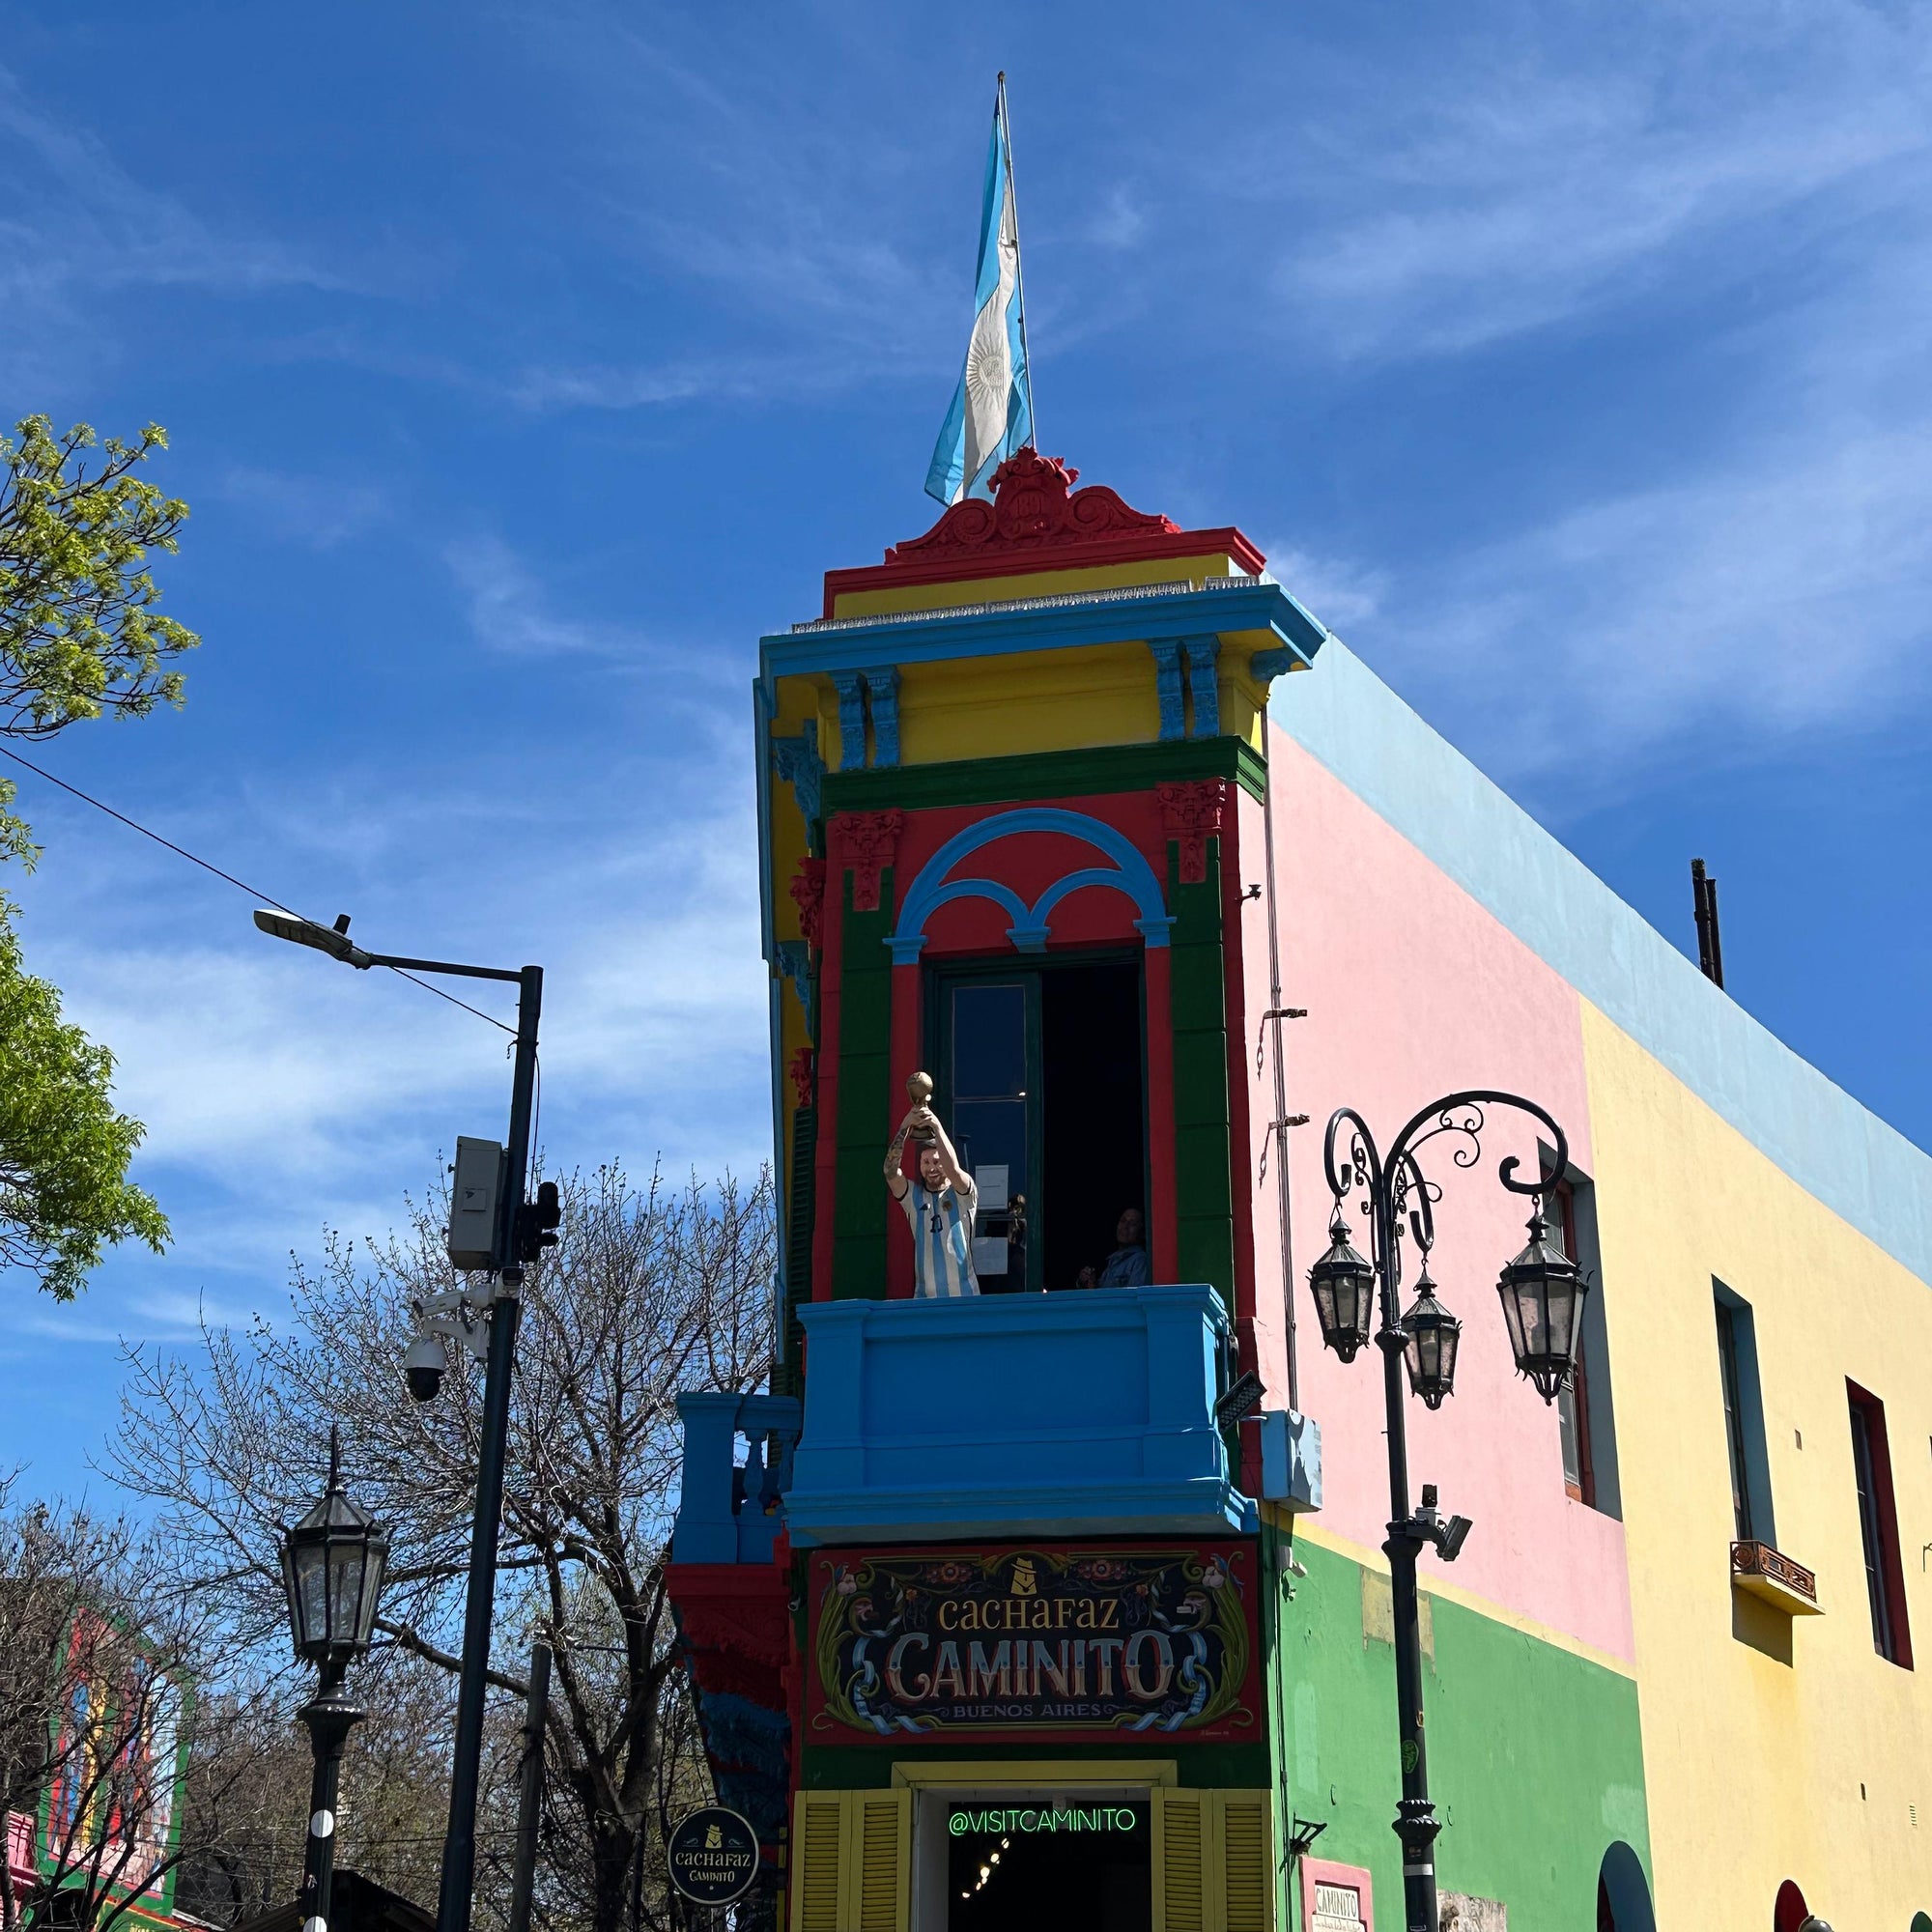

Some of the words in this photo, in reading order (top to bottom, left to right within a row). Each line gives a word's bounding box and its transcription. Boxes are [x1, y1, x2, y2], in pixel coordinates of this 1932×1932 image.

[885, 1630, 1174, 1699] CAMINITO
[953, 1704, 1034, 1719] BUENOS
[1041, 1704, 1101, 1718] AIRES
[950, 1809, 1135, 1836] @VISITCAMINITO
[689, 1870, 735, 1883] CAMINITO
[1316, 1888, 1357, 1918] CAMINITO
